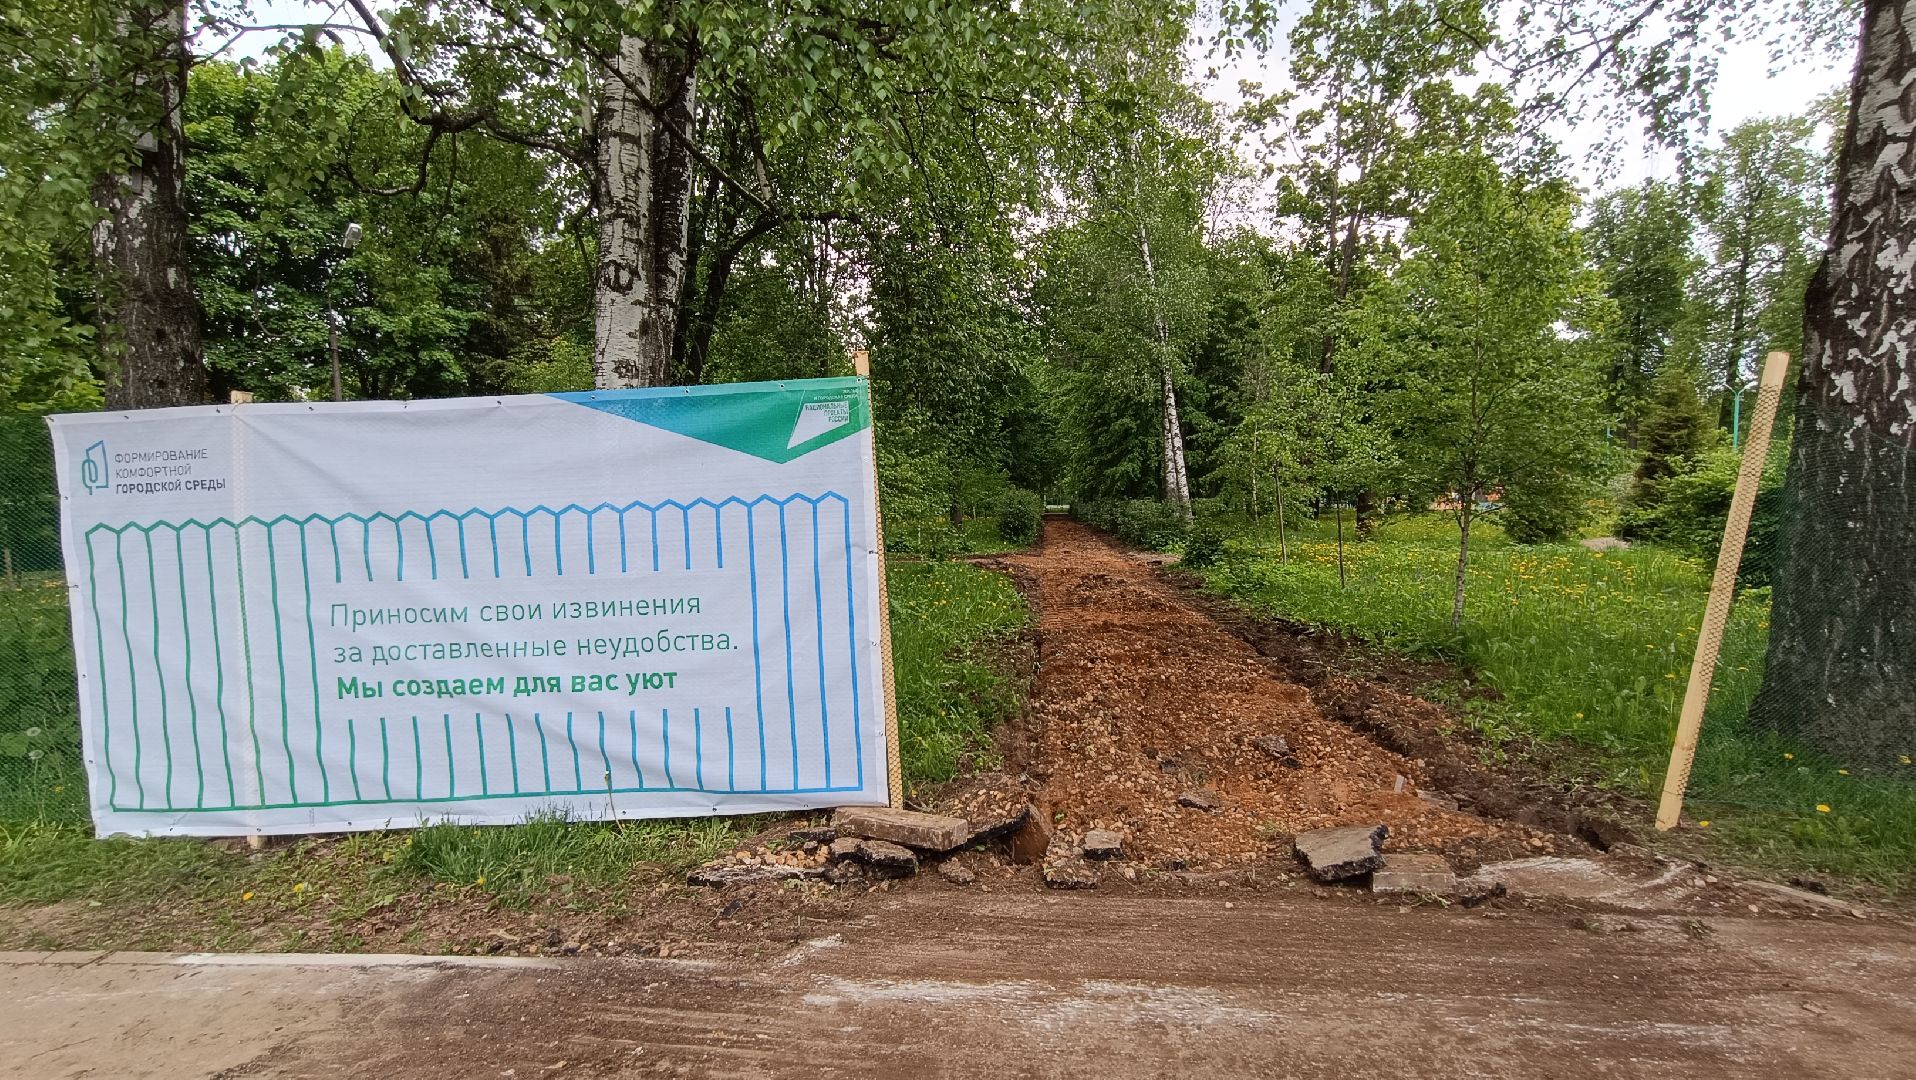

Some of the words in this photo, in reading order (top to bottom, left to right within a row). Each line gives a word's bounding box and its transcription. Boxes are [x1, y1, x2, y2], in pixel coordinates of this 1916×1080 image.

[828, 415, 849, 423] РОССИИ
[114, 449, 208, 463] ФОРМИРОВАНИЕ
[115, 464, 192, 479] КОМФОРТНОЙ
[116, 480, 182, 495] ГОРОДСКОЙ
[185, 478, 226, 491] СРЕДЫ
[330, 603, 468, 633] Приносим
[479, 603, 543, 623] свои
[552, 597, 701, 620] извинения
[333, 645, 363, 664] за
[372, 637, 567, 667] доставленные
[577, 629, 739, 662] неудобства.
[337, 676, 383, 700] Мы
[391, 675, 505, 700] создаем
[513, 675, 563, 698] для
[570, 671, 619, 694] вас
[626, 669, 679, 695] уют
